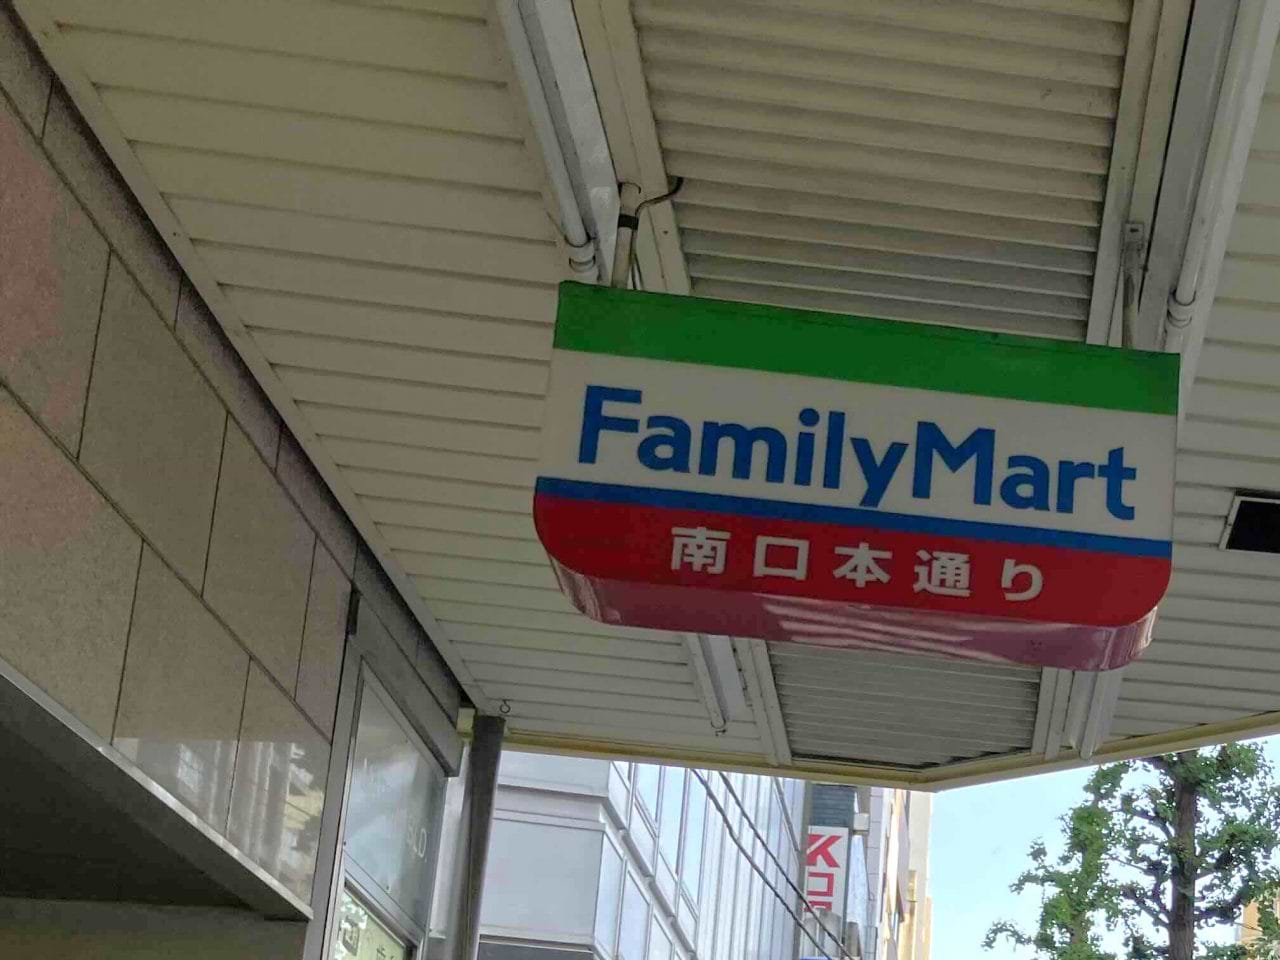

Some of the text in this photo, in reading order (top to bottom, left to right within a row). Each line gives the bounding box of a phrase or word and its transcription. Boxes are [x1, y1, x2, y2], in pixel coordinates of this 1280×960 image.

[577, 384, 1137, 521] FamilyMart
[669, 526, 1045, 602] 南口本通り
